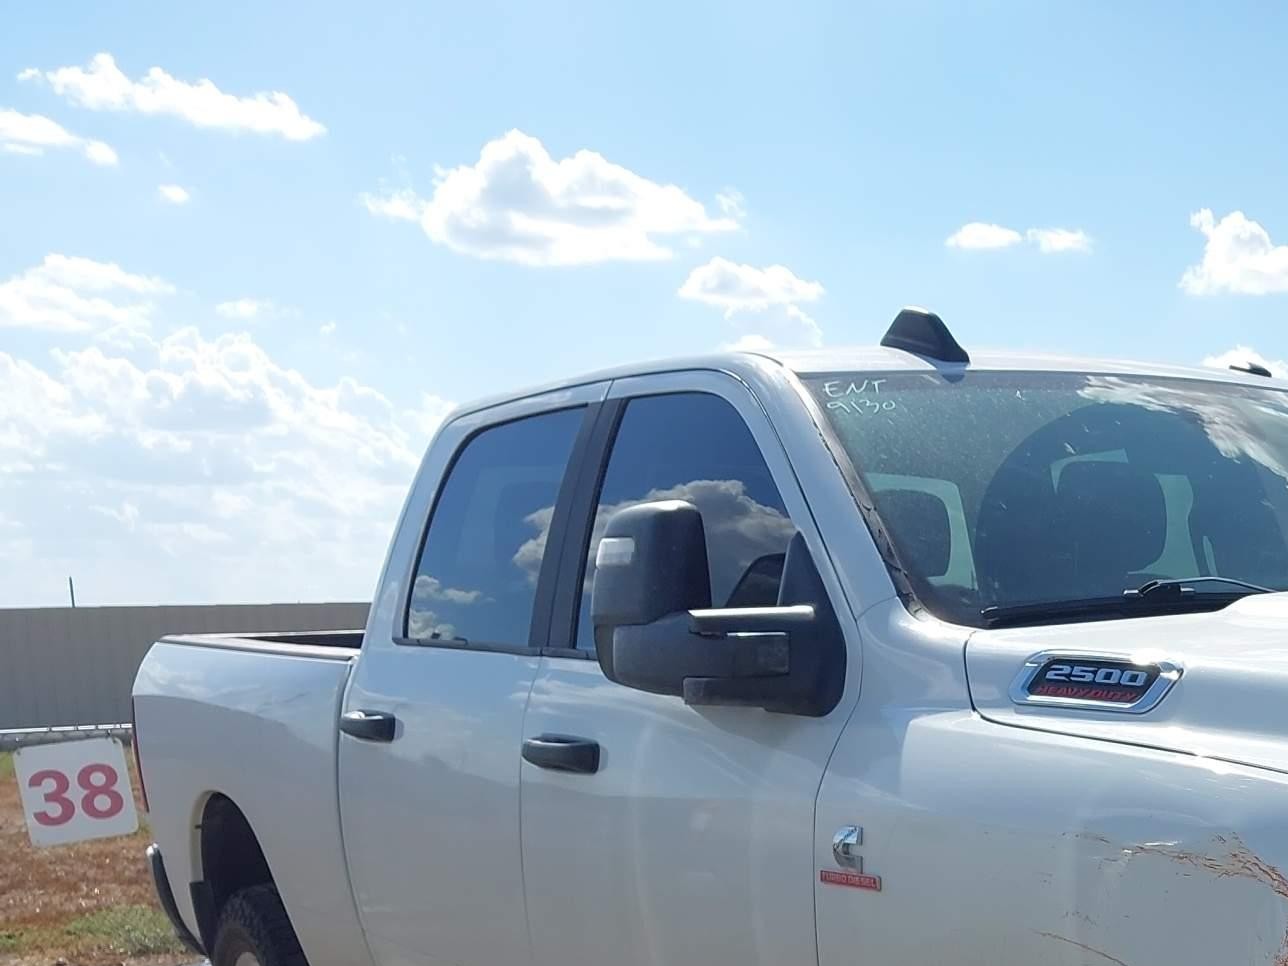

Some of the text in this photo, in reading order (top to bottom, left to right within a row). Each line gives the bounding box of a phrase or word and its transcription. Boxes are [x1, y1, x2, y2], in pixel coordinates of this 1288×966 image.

[822, 379, 887, 397] ENT
[1045, 664, 1148, 687] 2500
[28, 763, 124, 826] 38
